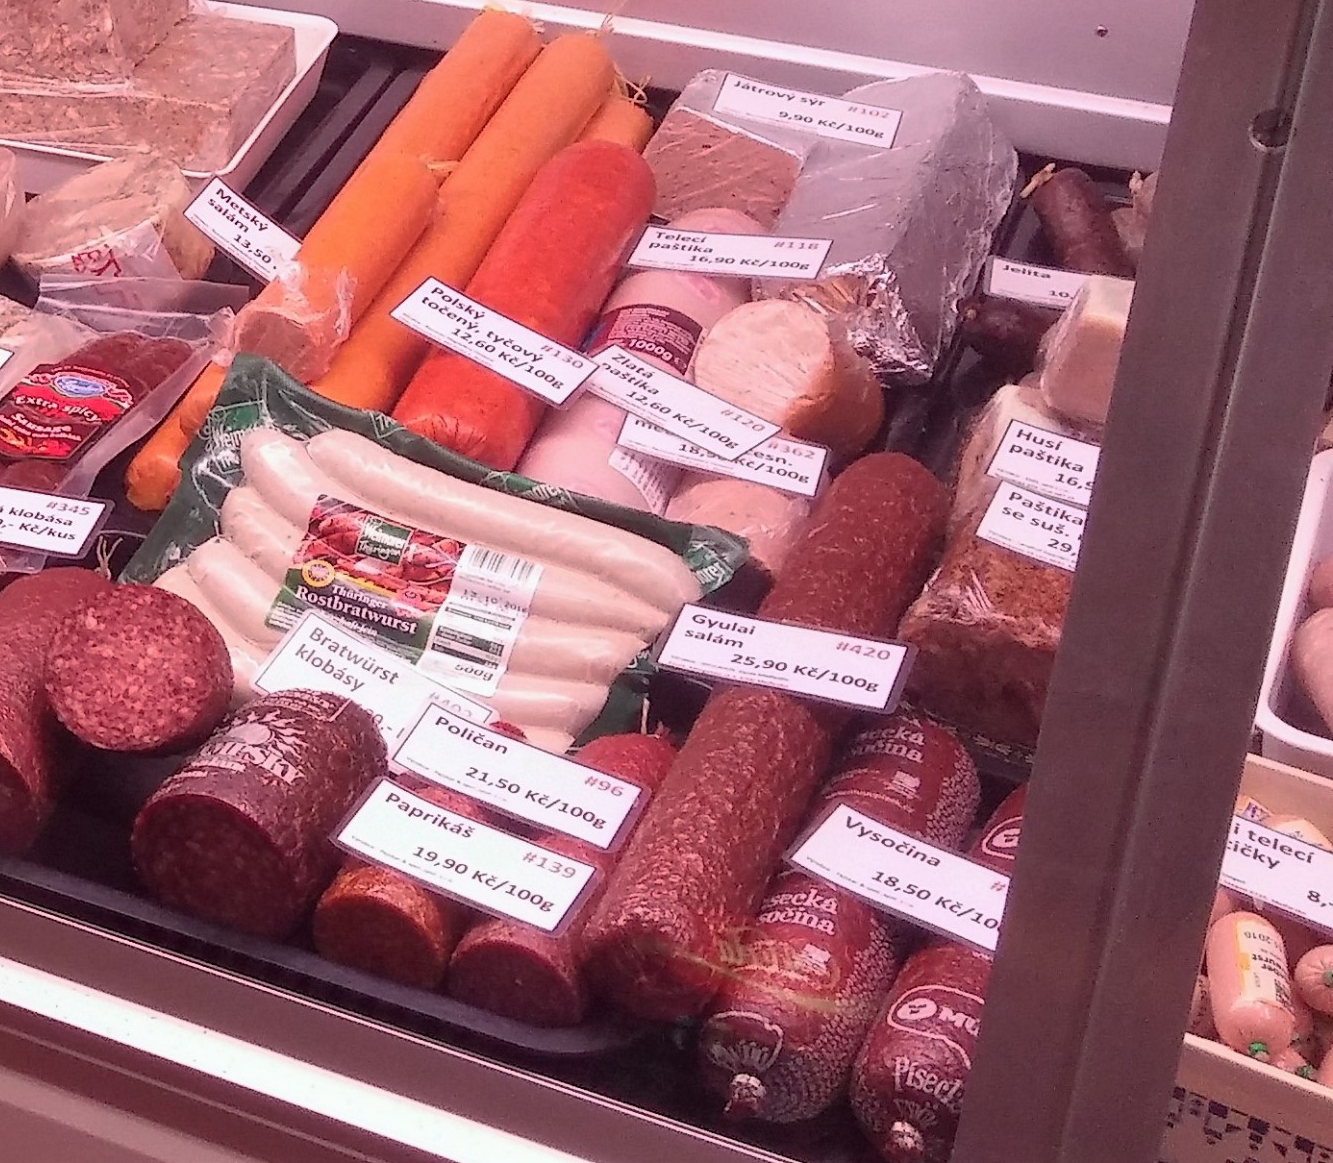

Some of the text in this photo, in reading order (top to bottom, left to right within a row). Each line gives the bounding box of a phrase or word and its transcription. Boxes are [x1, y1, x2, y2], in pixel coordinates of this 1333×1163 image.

[818, 118, 885, 139] Kč/100g
[207, 198, 249, 233] salám
[215, 187, 269, 232] Metský
[233, 233, 272, 265] 13,50
[648, 240, 713, 255] paštika
[655, 231, 707, 244] Telecí
[689, 254, 811, 271] 16,90 Kč/100g
[1002, 264, 1051, 279] Jelita
[421, 297, 544, 363] točený, tyčový
[431, 287, 584, 369] Polský #130
[451, 328, 565, 390] 12,60 Kč/100g
[15, 394, 59, 409] Extra
[611, 352, 766, 432] Zlatá #120
[625, 390, 672, 416] 12,60
[672, 411, 740, 450] Kč/100g
[767, 440, 817, 460] #362
[1008, 443, 1084, 473] paštika
[1016, 428, 1063, 452] Husí
[7, 505, 73, 528] klobása
[45, 500, 90, 516] #345
[1002, 504, 1070, 539] se suš.
[1009, 490, 1083, 526] Paštika
[18, 519, 77, 542] Kč/kus
[295, 586, 418, 635] Rostbratwurst
[684, 629, 743, 648] salám
[691, 614, 891, 661] Gyulai #420
[295, 644, 365, 692] klobásy
[309, 627, 400, 685] Bratwürst
[730, 653, 879, 693] 25,90 Kč/100g
[434, 716, 508, 755] Poličan
[584, 774, 624, 798] #96
[465, 767, 607, 830] 21,50 Kč/100g
[385, 792, 577, 879] Paprikáš #139
[845, 815, 941, 867] Vysočina
[1247, 829, 1315, 864] telecí
[412, 846, 556, 913] 19,90 Kč/100g
[872, 871, 1000, 930] 18,50 Kč/10
